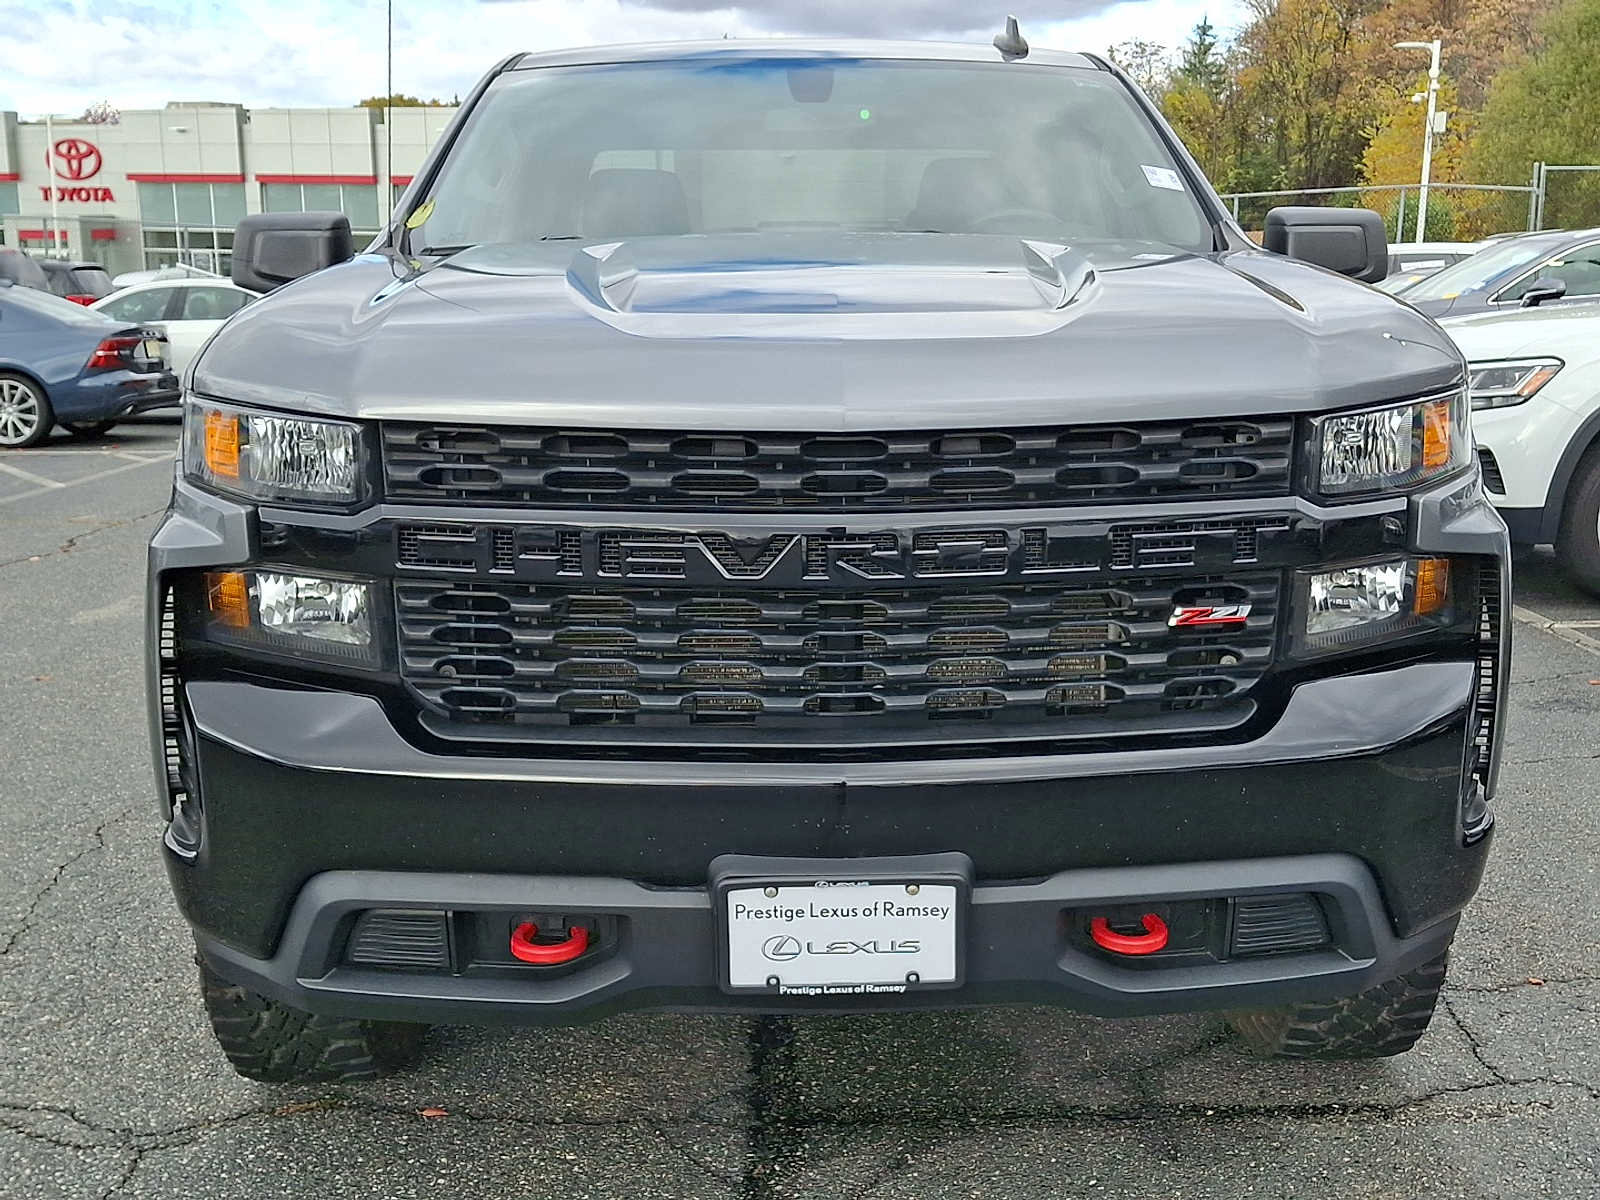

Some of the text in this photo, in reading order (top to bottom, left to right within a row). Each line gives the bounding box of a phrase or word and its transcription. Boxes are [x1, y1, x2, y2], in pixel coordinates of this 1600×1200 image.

[40, 187, 115, 202] TOYOTA
[395, 516, 1290, 580] CHEVROLET
[1168, 605, 1252, 626] Z71
[735, 900, 949, 922] Prestige Lexus of Ramsey
[806, 940, 920, 955] LEXUS
[780, 984, 906, 996] Prestige Lexus of Ramsey
